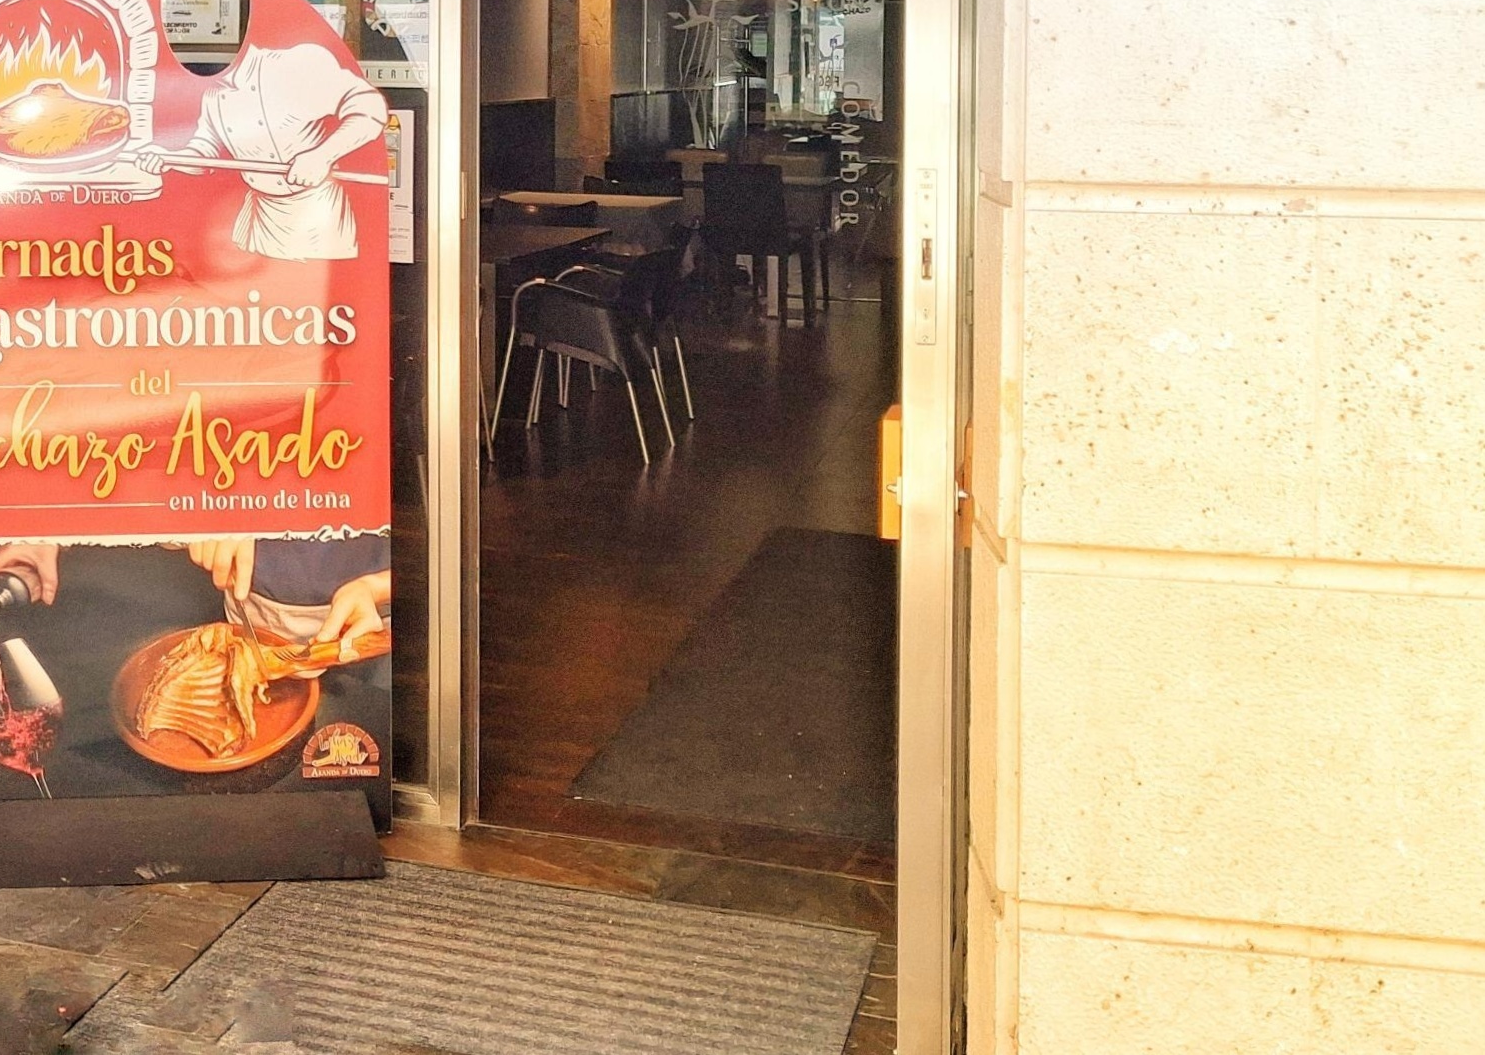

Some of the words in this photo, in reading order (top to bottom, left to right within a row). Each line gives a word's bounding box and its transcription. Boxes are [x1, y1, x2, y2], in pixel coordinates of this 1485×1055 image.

[840, 81, 861, 227] COMEDOR
[50, 191, 66, 203] DE
[71, 184, 134, 205] DUERO
[129, 369, 172, 396] del
[166, 386, 364, 490] Asado
[169, 494, 195, 511] en
[201, 490, 267, 511] horno
[273, 489, 299, 510] de
[305, 488, 352, 510] leña
